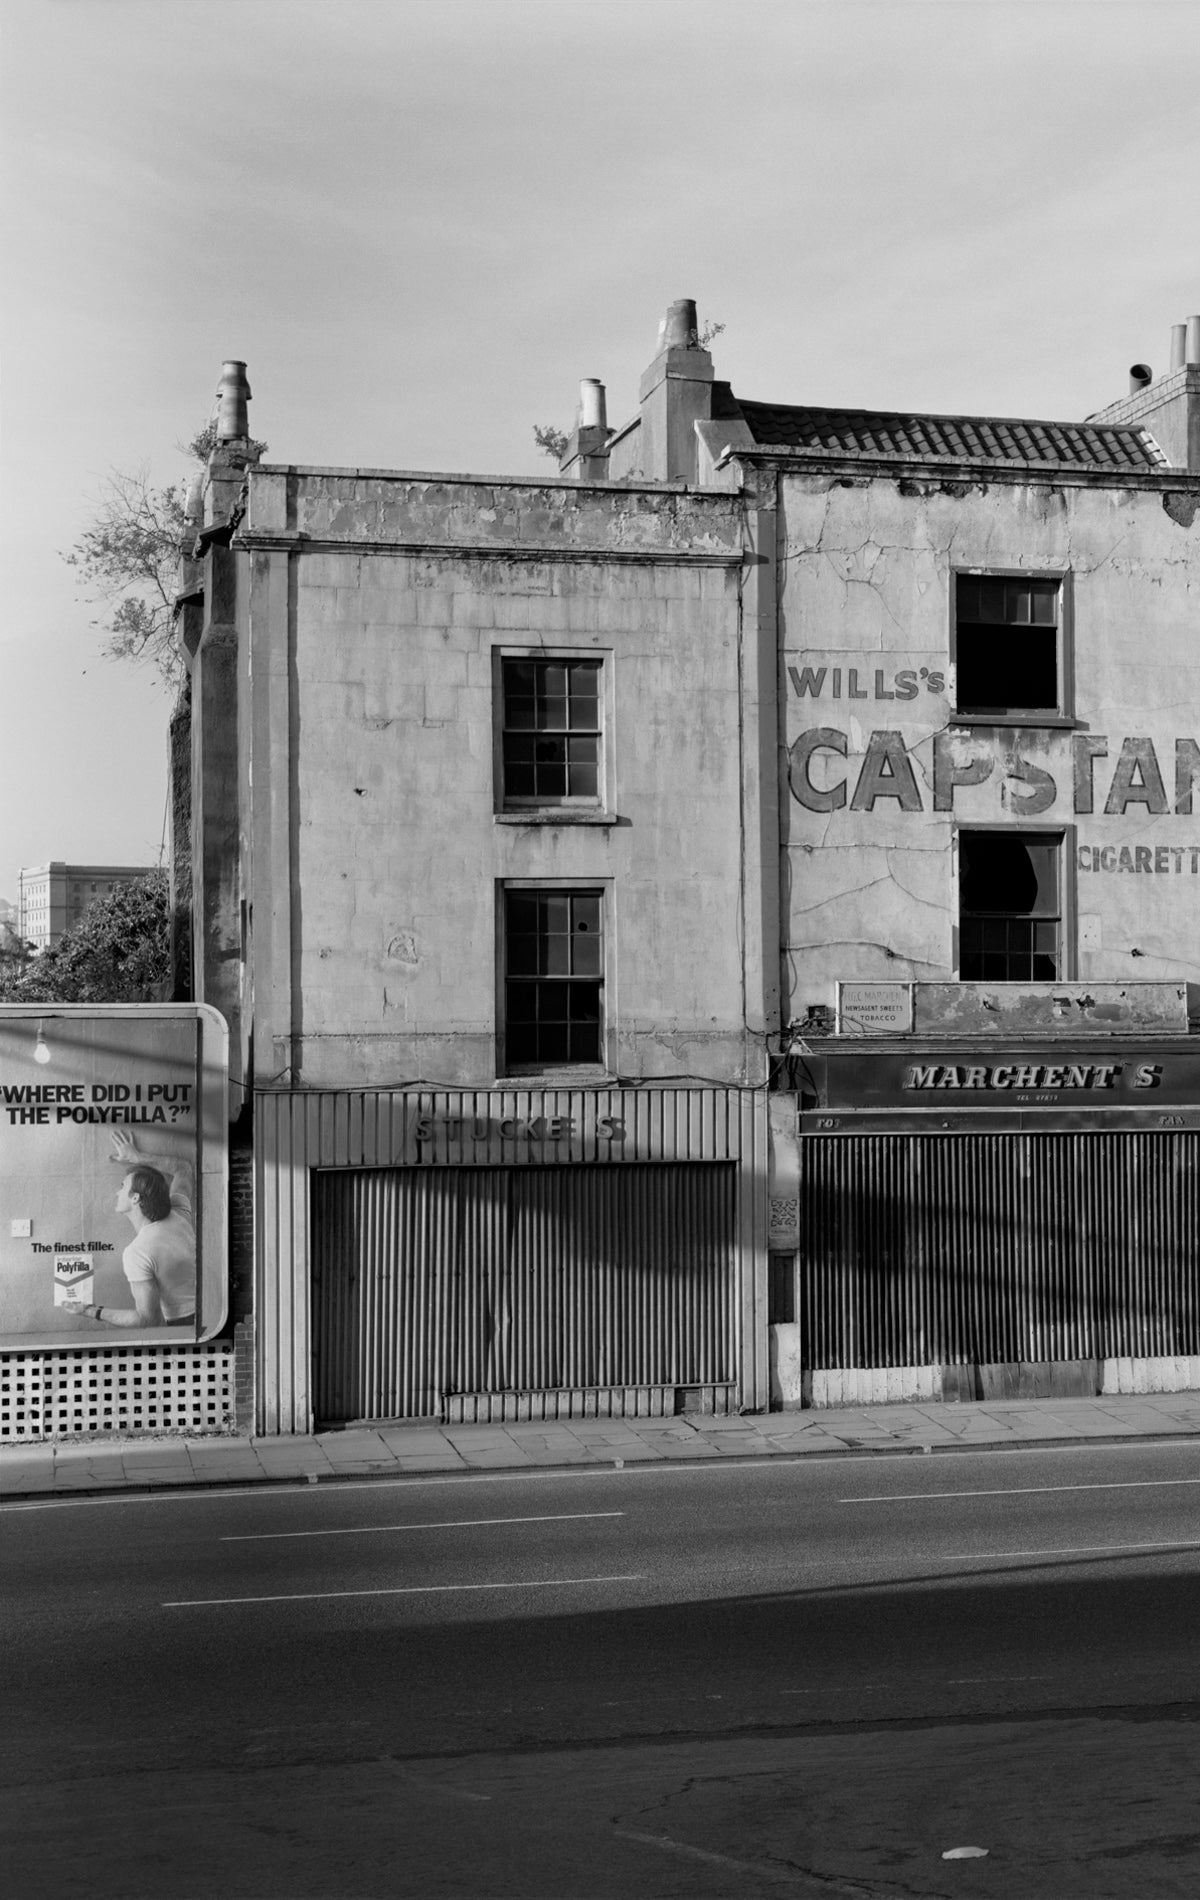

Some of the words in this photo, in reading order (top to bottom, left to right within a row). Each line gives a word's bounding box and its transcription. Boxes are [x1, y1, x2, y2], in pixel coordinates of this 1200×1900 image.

[92, 1085, 130, 1102] DID
[135, 1084, 142, 1102] I
[148, 1084, 192, 1102] PUT
[6, 1107, 50, 1125] THE
[31, 1242, 53, 1253] The
[54, 1242, 86, 1252] finest
[87, 1241, 115, 1252] filler.
[57, 1262, 89, 1274] Polyfilla
